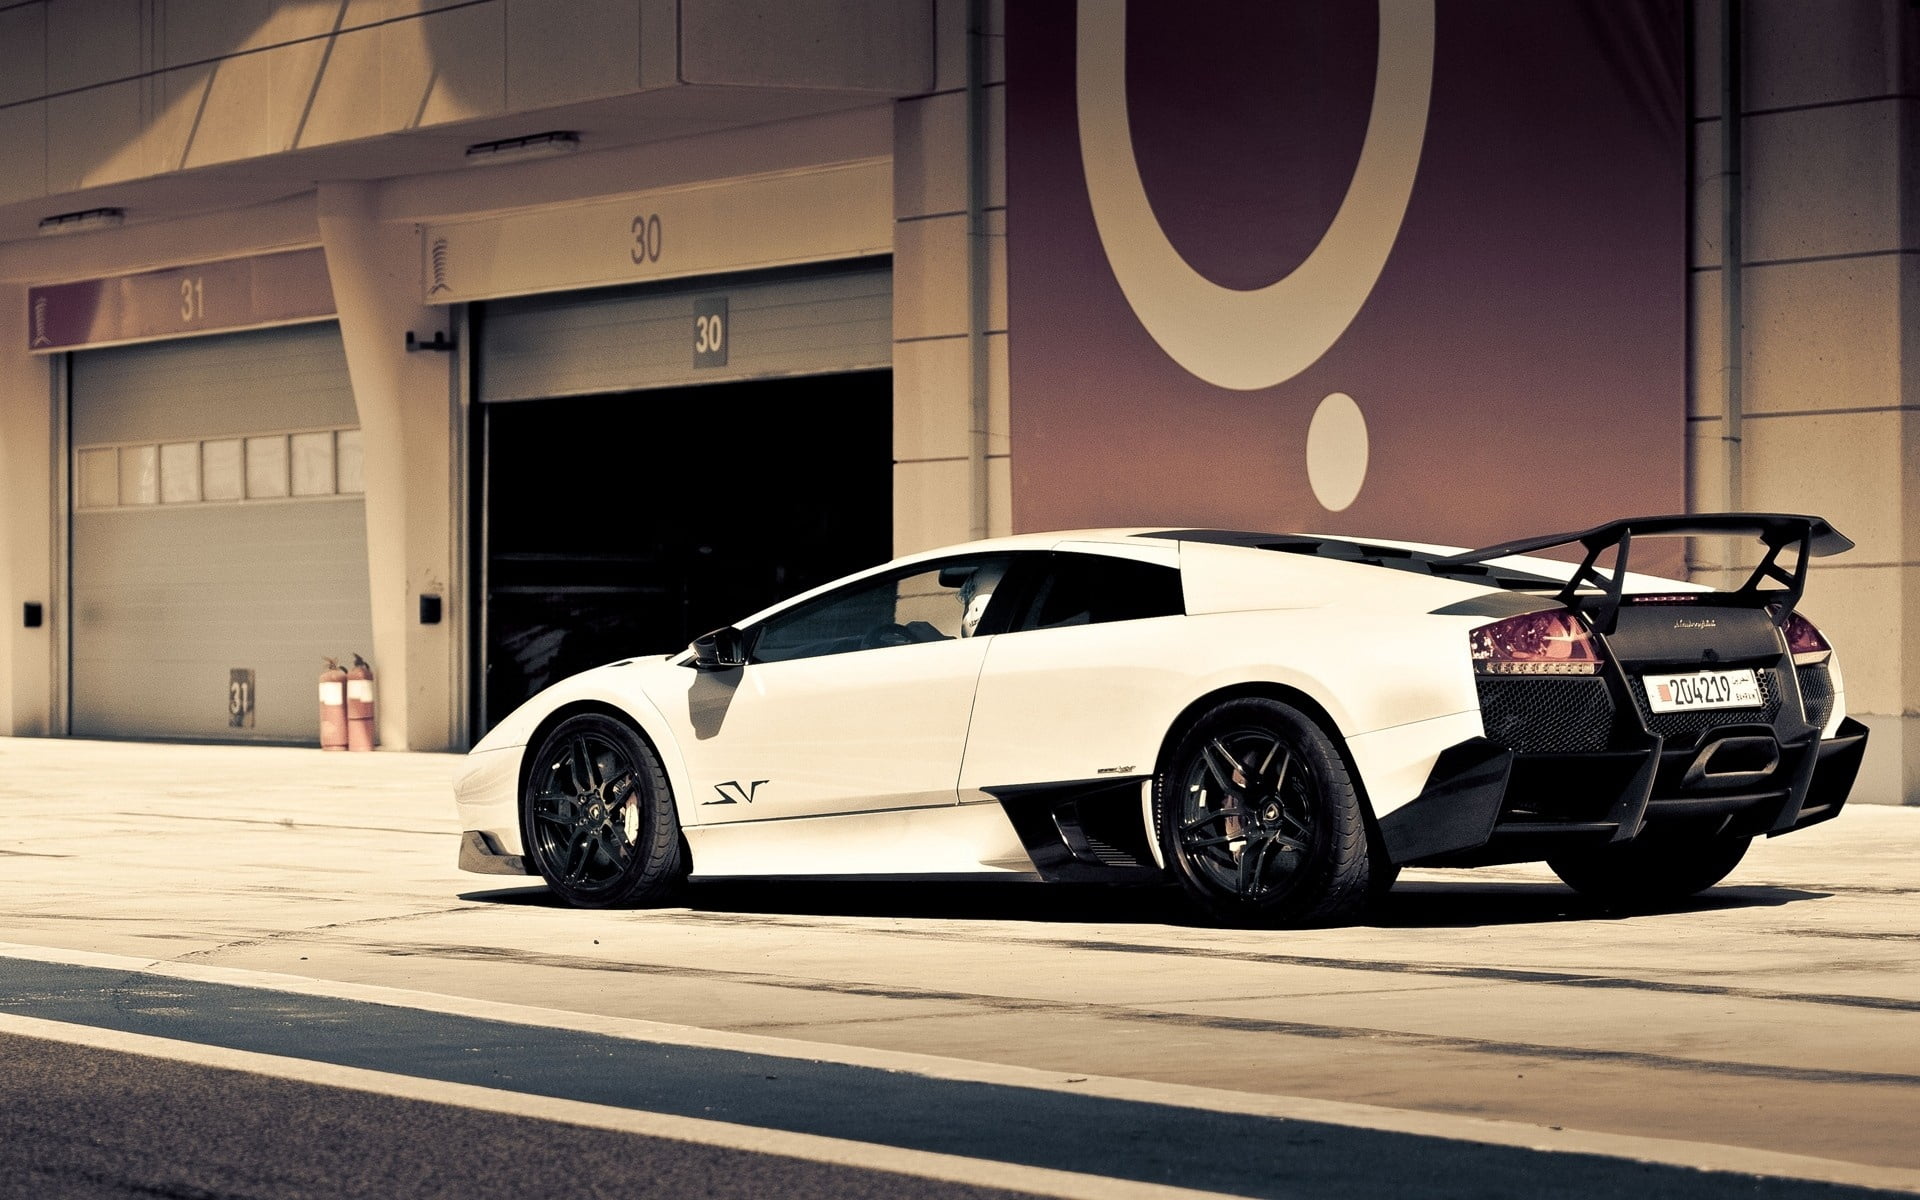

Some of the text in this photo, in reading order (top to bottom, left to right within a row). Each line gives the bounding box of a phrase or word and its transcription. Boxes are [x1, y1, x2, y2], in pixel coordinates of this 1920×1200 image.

[631, 213, 661, 265] 30
[181, 278, 203, 322] 31
[696, 314, 722, 353] 30
[230, 682, 248, 714] 31
[1670, 675, 1731, 705] 204219
[701, 779, 770, 805] SV
